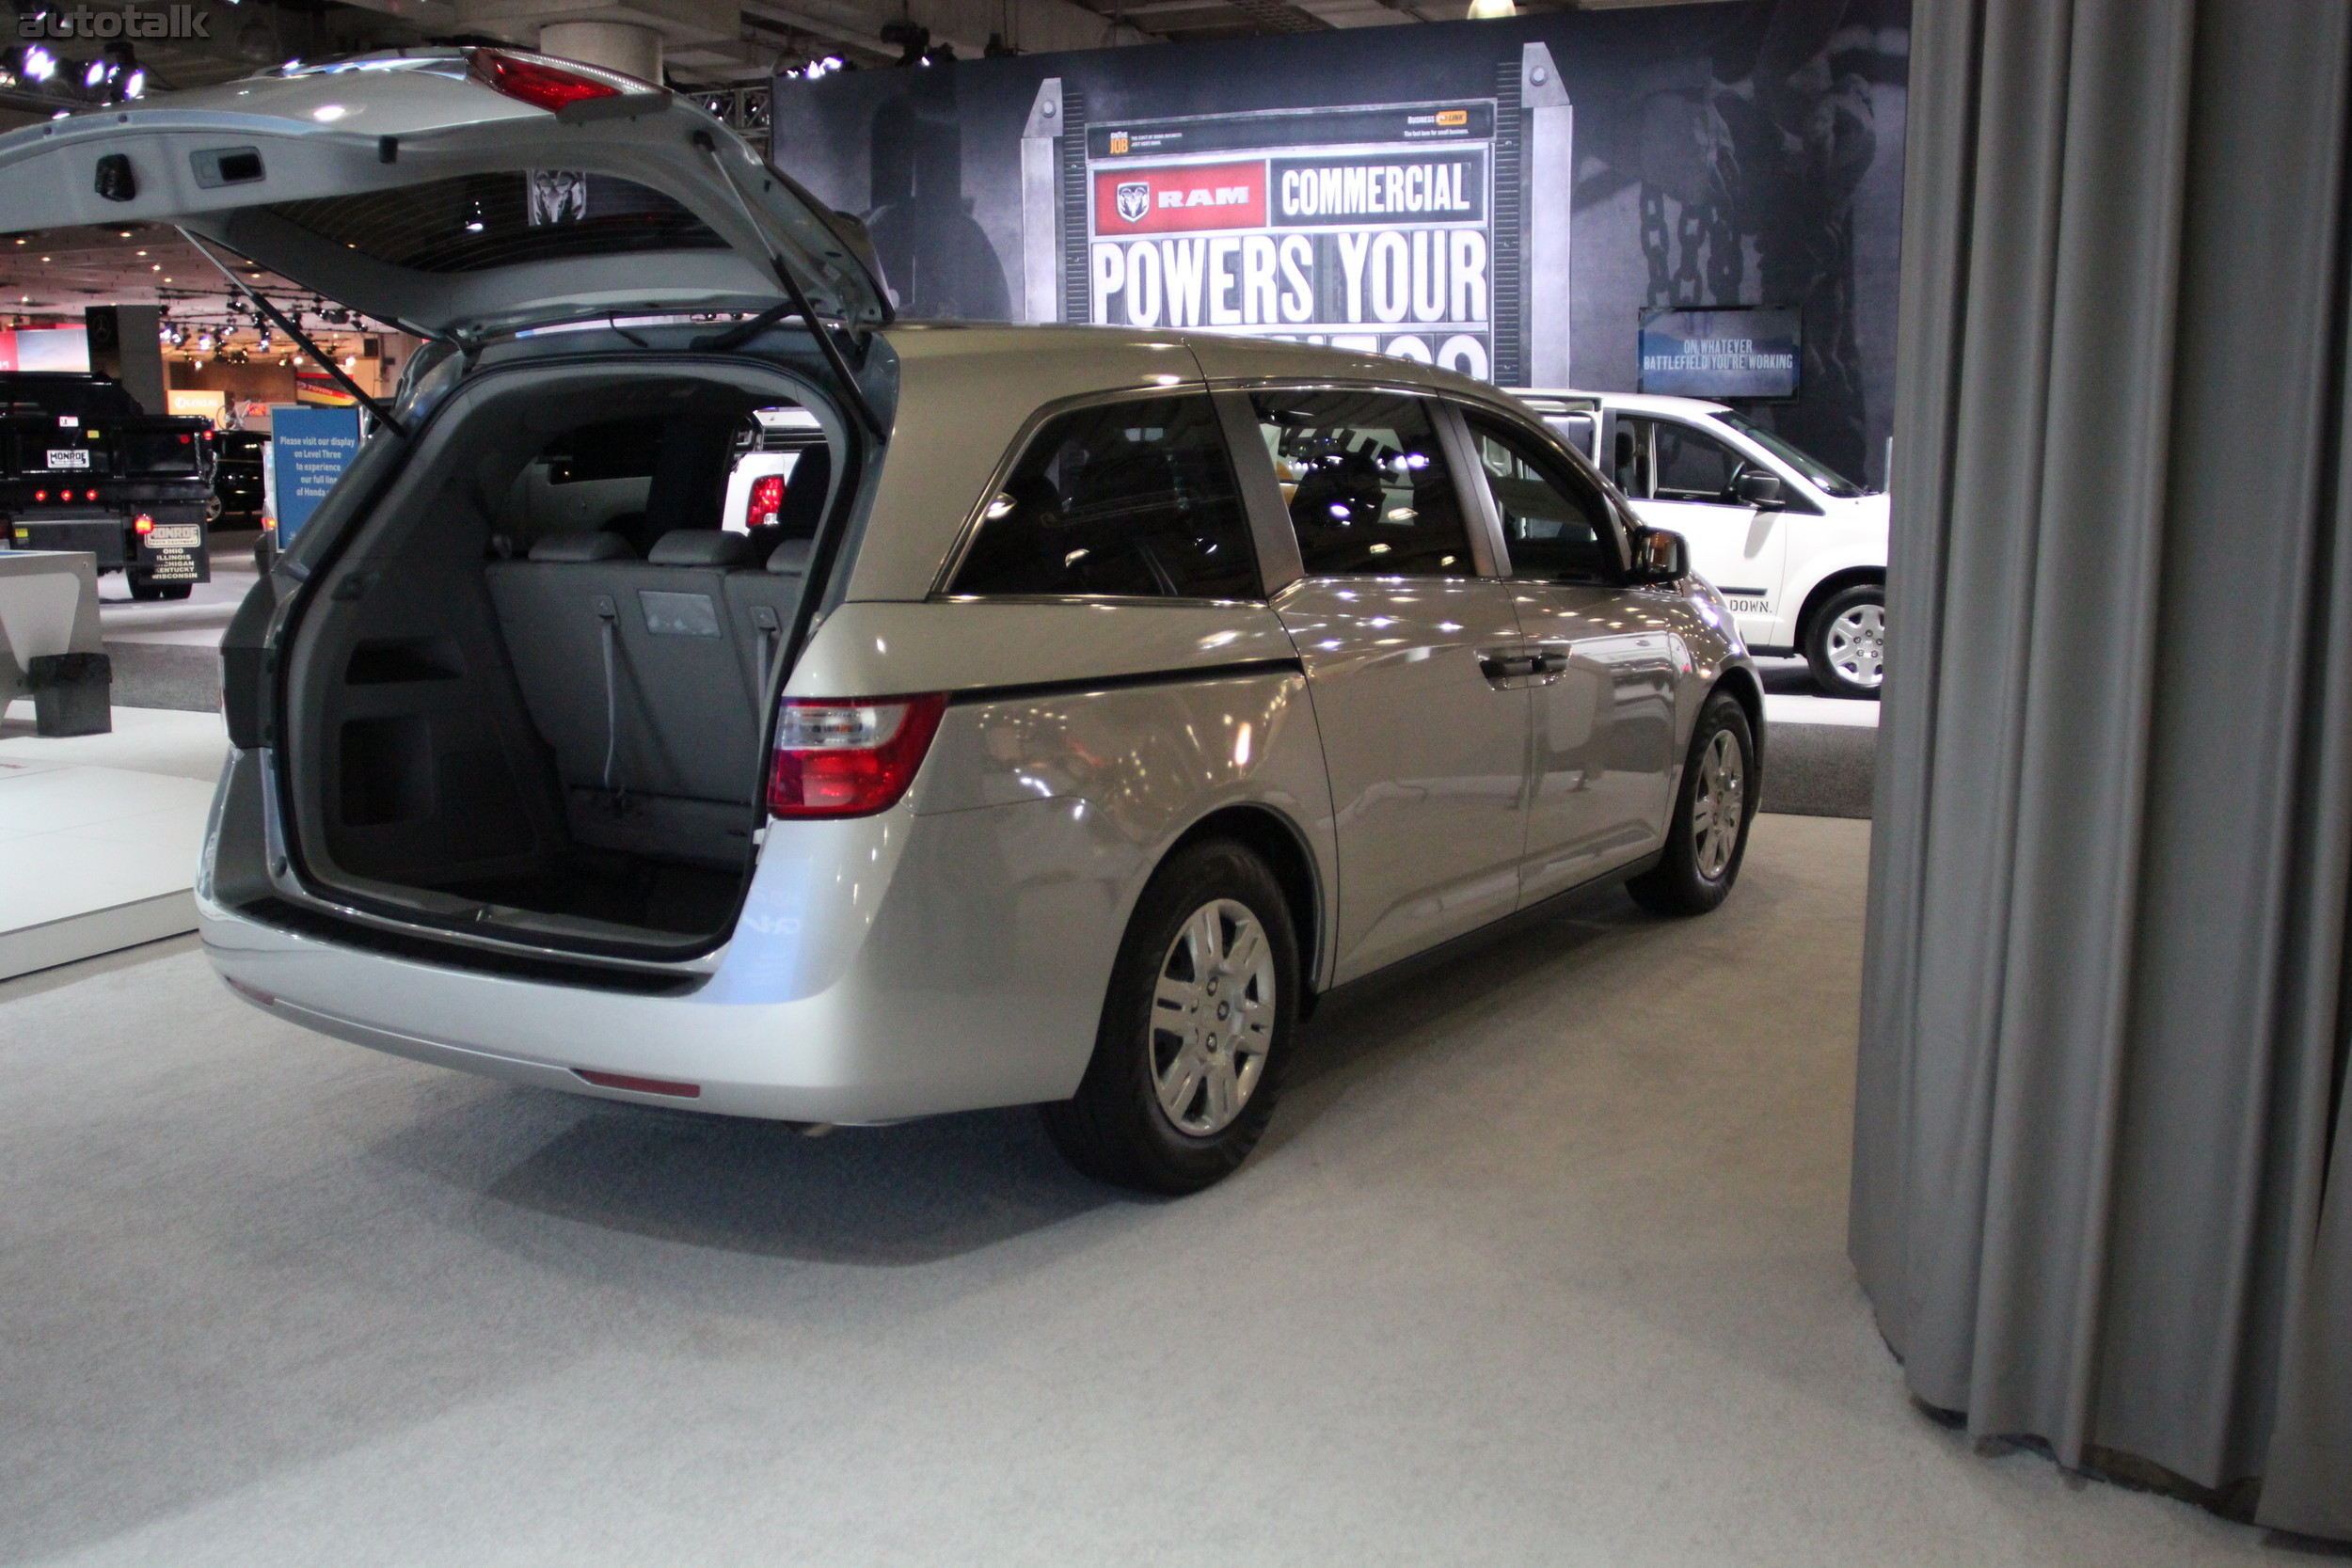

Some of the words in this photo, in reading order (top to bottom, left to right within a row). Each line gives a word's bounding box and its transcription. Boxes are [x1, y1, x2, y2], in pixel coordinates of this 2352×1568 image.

[1110, 138, 1129, 154] JOB
[1282, 163, 1470, 215] COMMERCIAL
[1158, 186, 1249, 209] RAM
[1092, 234, 1313, 327] POWERS
[1337, 230, 1488, 323] YOUR
[1683, 340, 1698, 354] ON
[1700, 339, 1753, 354] WHATEVER
[1644, 355, 1708, 370] BATTLEFIELD
[1711, 354, 1744, 370] YOU'RE
[1748, 354, 1793, 369] WORKING
[279, 436, 302, 446] Please
[302, 436, 317, 446] visit
[330, 436, 356, 448] display
[50, 451, 87, 461] MONROE
[304, 450, 322, 458] Level
[322, 450, 342, 459] Three
[295, 463, 303, 471] to
[304, 463, 342, 473] experience
[312, 475, 324, 484] full
[295, 487, 304, 497] of
[304, 487, 326, 497] Honda
[1729, 600, 1772, 613] DOWN.
